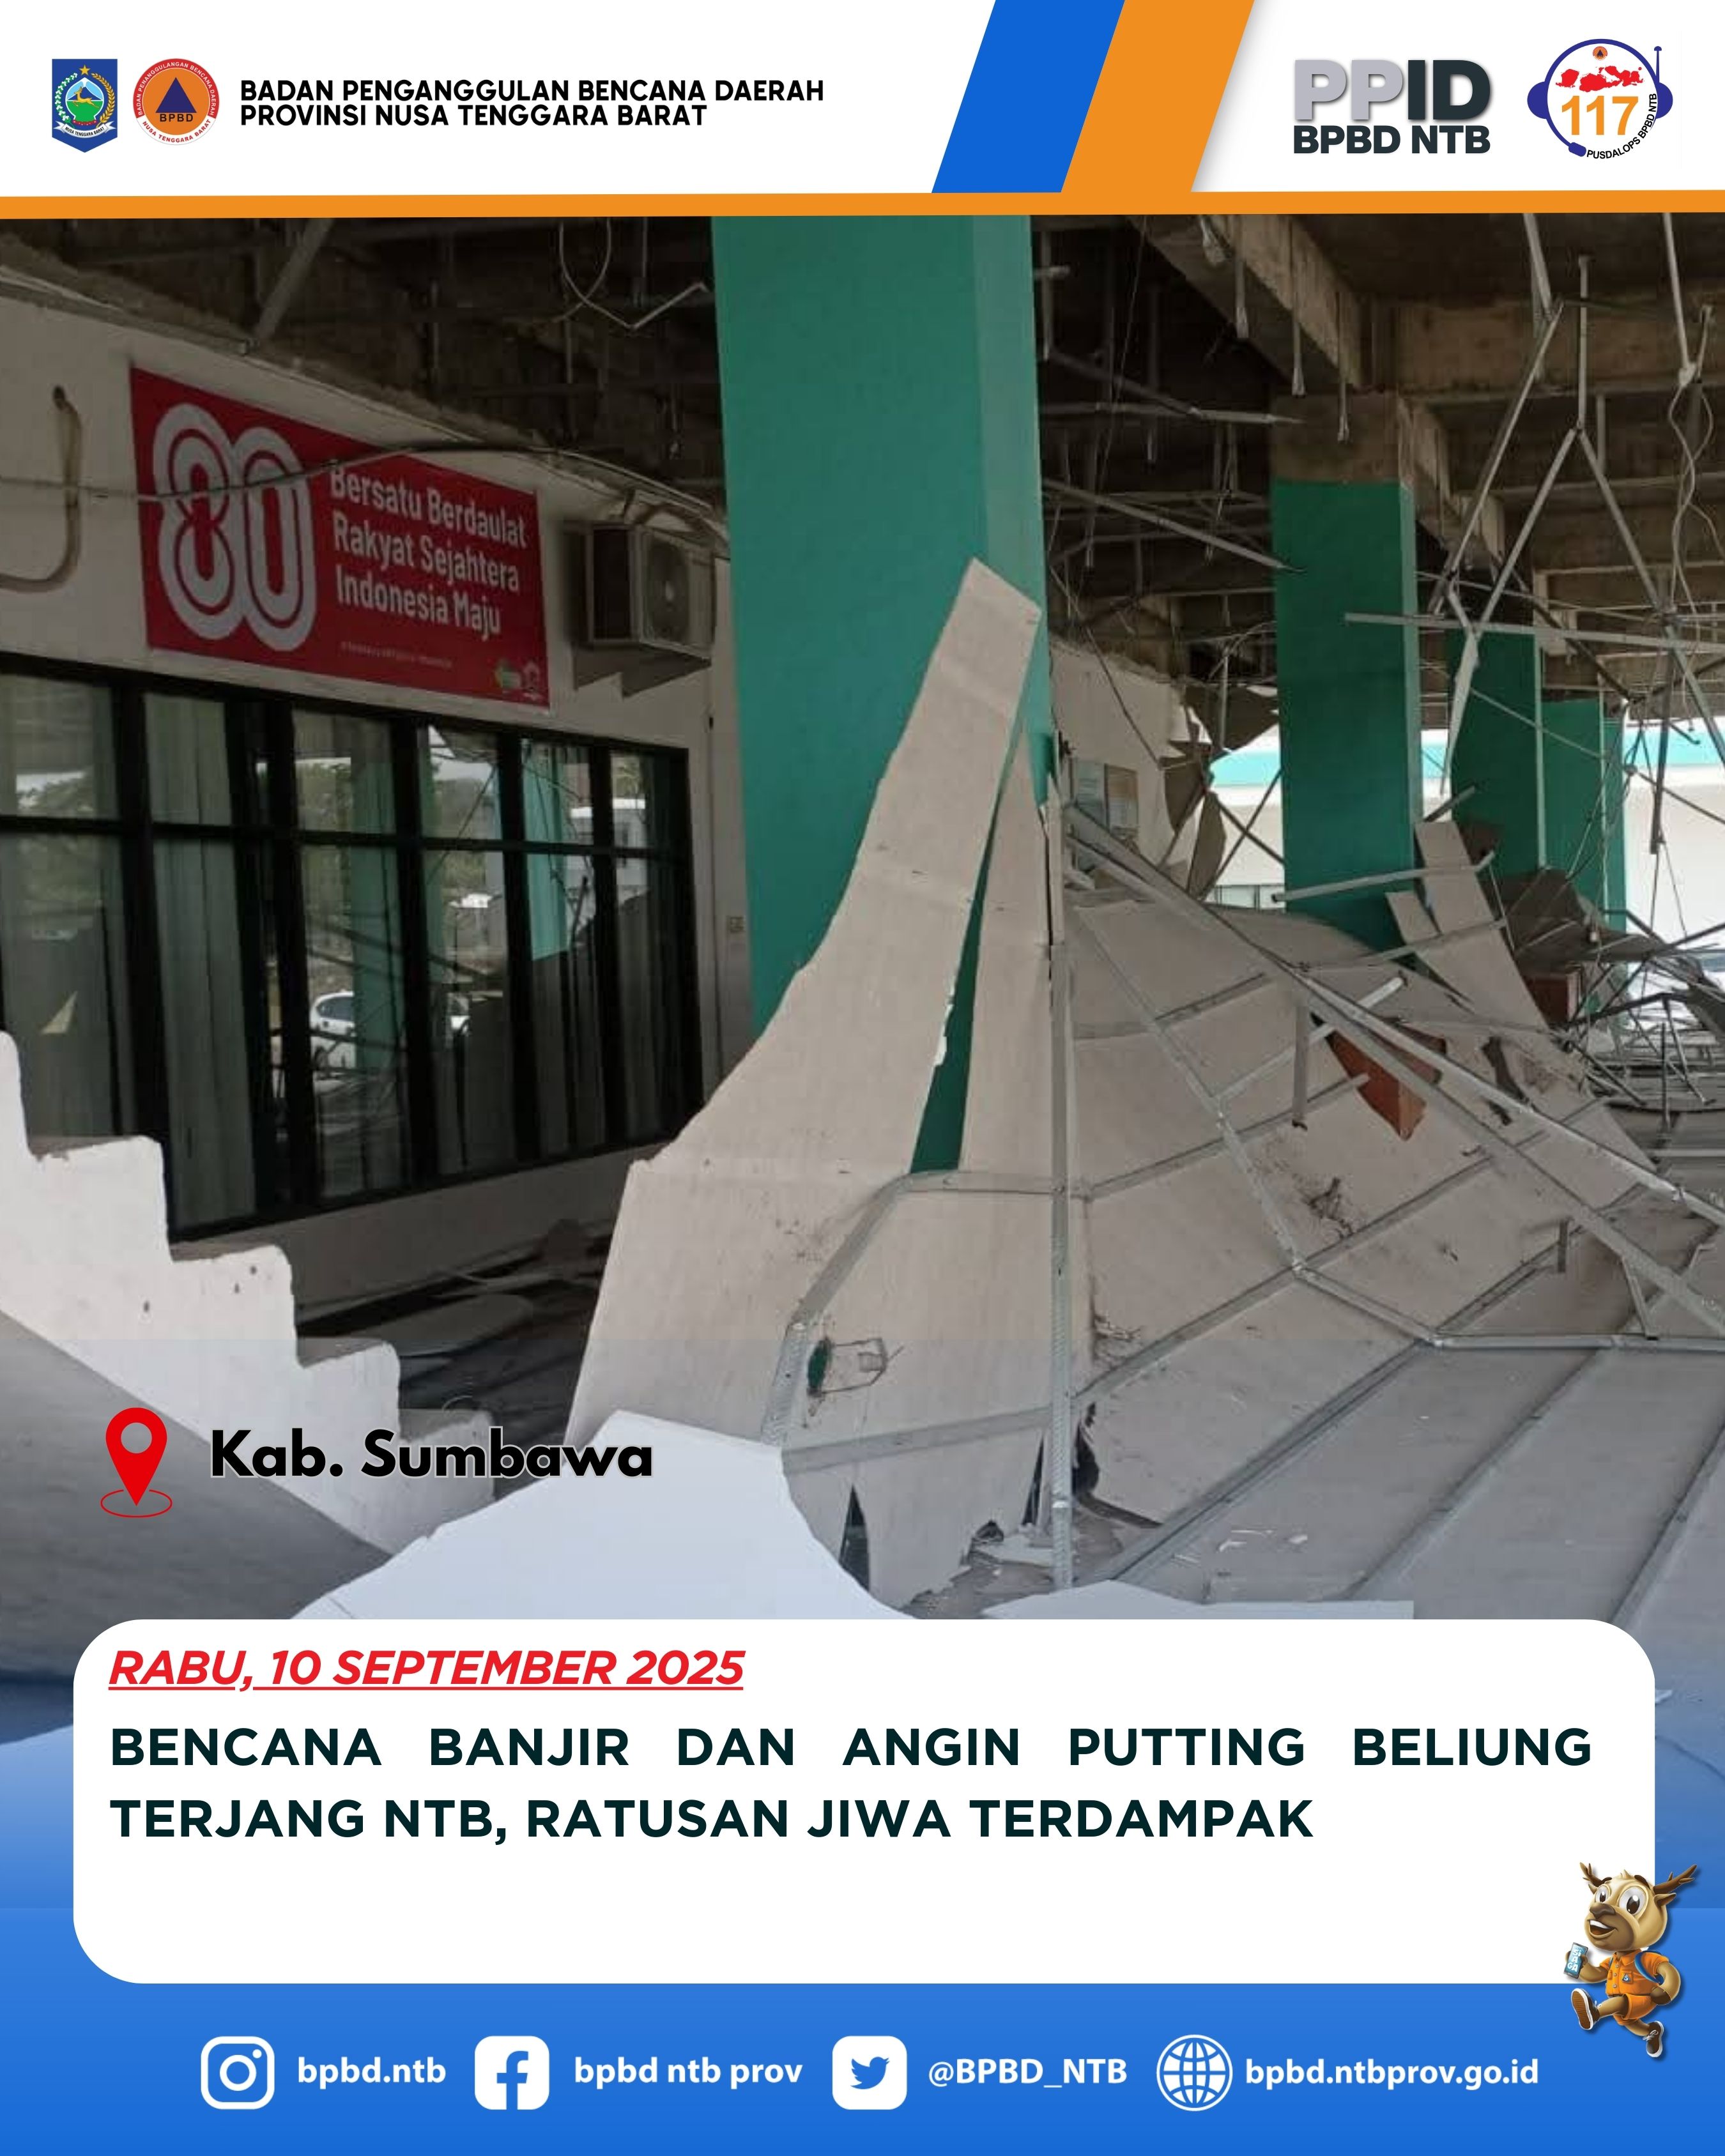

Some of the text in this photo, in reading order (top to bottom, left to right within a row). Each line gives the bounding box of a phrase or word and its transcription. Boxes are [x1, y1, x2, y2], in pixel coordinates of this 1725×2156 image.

[153, 403, 316, 651] 80
[330, 467, 526, 548] Bersatu Berdaulat
[333, 510, 519, 592] Rakyat Sejahtera
[335, 565, 500, 641] Indonesia Maju
